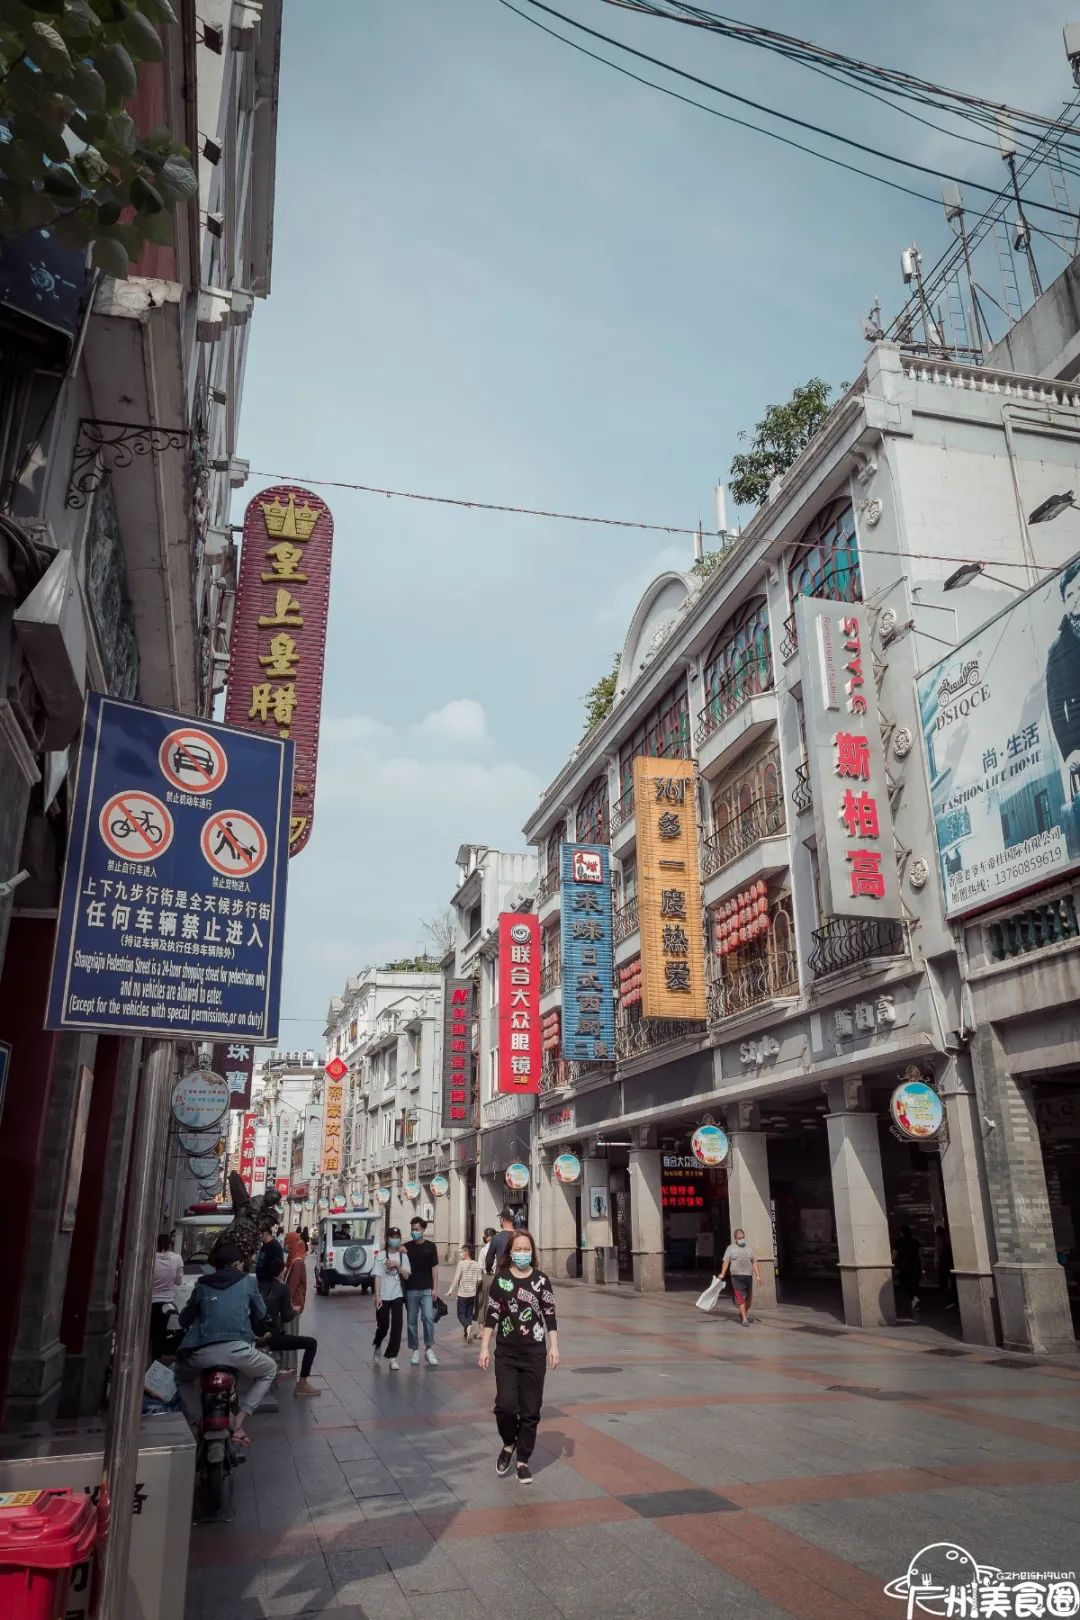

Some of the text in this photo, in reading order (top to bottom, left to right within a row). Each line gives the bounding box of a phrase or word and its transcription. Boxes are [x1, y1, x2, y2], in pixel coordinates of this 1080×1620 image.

[166, 791, 213, 810] 禁止机动车通行
[833, 731, 886, 899] 斯柏高
[107, 860, 157, 878] 禁止自行车进入
[212, 876, 251, 893] 禁止宠物进入
[996, 846, 1062, 886] 13760859619
[83, 876, 271, 921] 上下九步行街是全天候步行街
[86, 900, 263, 948] 任何车辆禁止进入
[106, 953, 134, 973] Pedestrian
[135, 957, 151, 975] Street
[151, 958, 157, 975] is
[162, 960, 181, 978] 24-hour
[182, 962, 204, 984] shopping
[205, 965, 220, 982] street
[228, 967, 255, 988] pedestrians
[255, 970, 266, 991] only
[120, 976, 133, 996] and
[133, 980, 141, 998] no
[142, 978, 166, 999] vehicles
[166, 984, 176, 1001] are
[177, 981, 199, 1003] allowed
[199, 984, 206, 1004] to
[69, 994, 95, 1015] (Except
[96, 997, 108, 1014] for
[109, 998, 121, 1014] the
[123, 1000, 149, 1017] vehicles
[151, 1002, 166, 1018] with
[167, 1004, 190, 1023] special
[238, 1013, 246, 1025] on
[247, 1010, 263, 1030] duty)
[511, 945, 531, 1075] 联合大众眼镜
